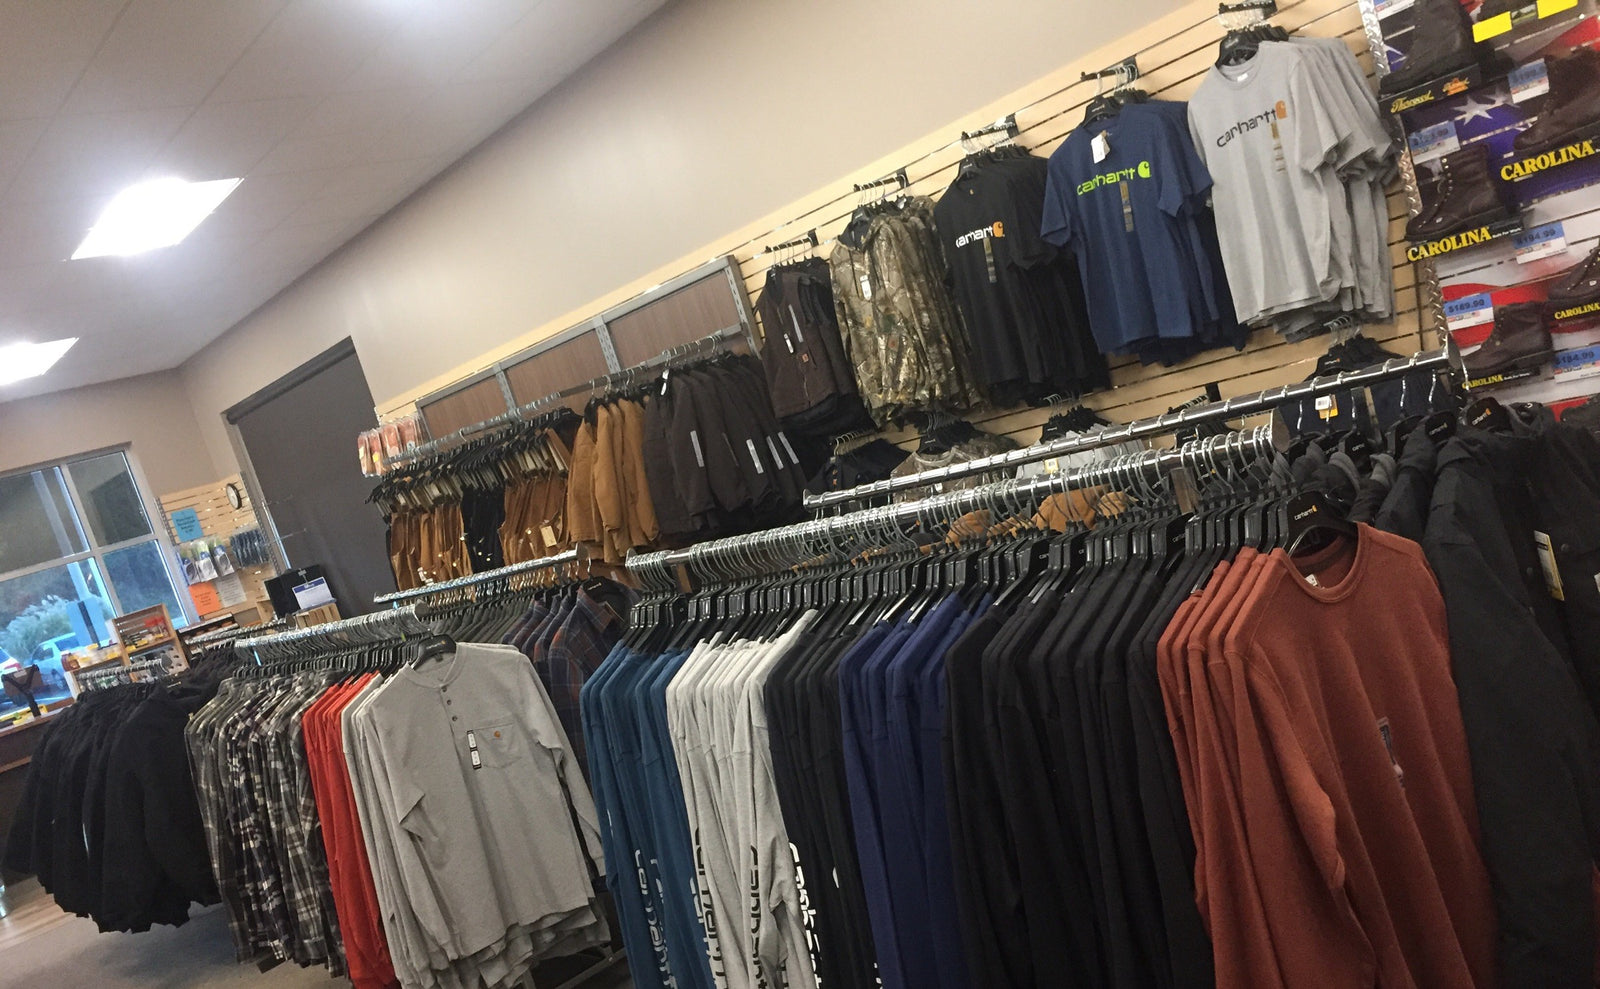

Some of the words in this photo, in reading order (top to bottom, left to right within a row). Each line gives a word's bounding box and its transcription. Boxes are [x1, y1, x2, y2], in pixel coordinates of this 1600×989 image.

[1217, 109, 1277, 147] carhartt
[1501, 141, 1596, 181] CAROLINA
[1407, 227, 1492, 262] CAROLINA
[1554, 302, 1600, 320] CAROLINA
[1462, 374, 1503, 389] CAROLINA
